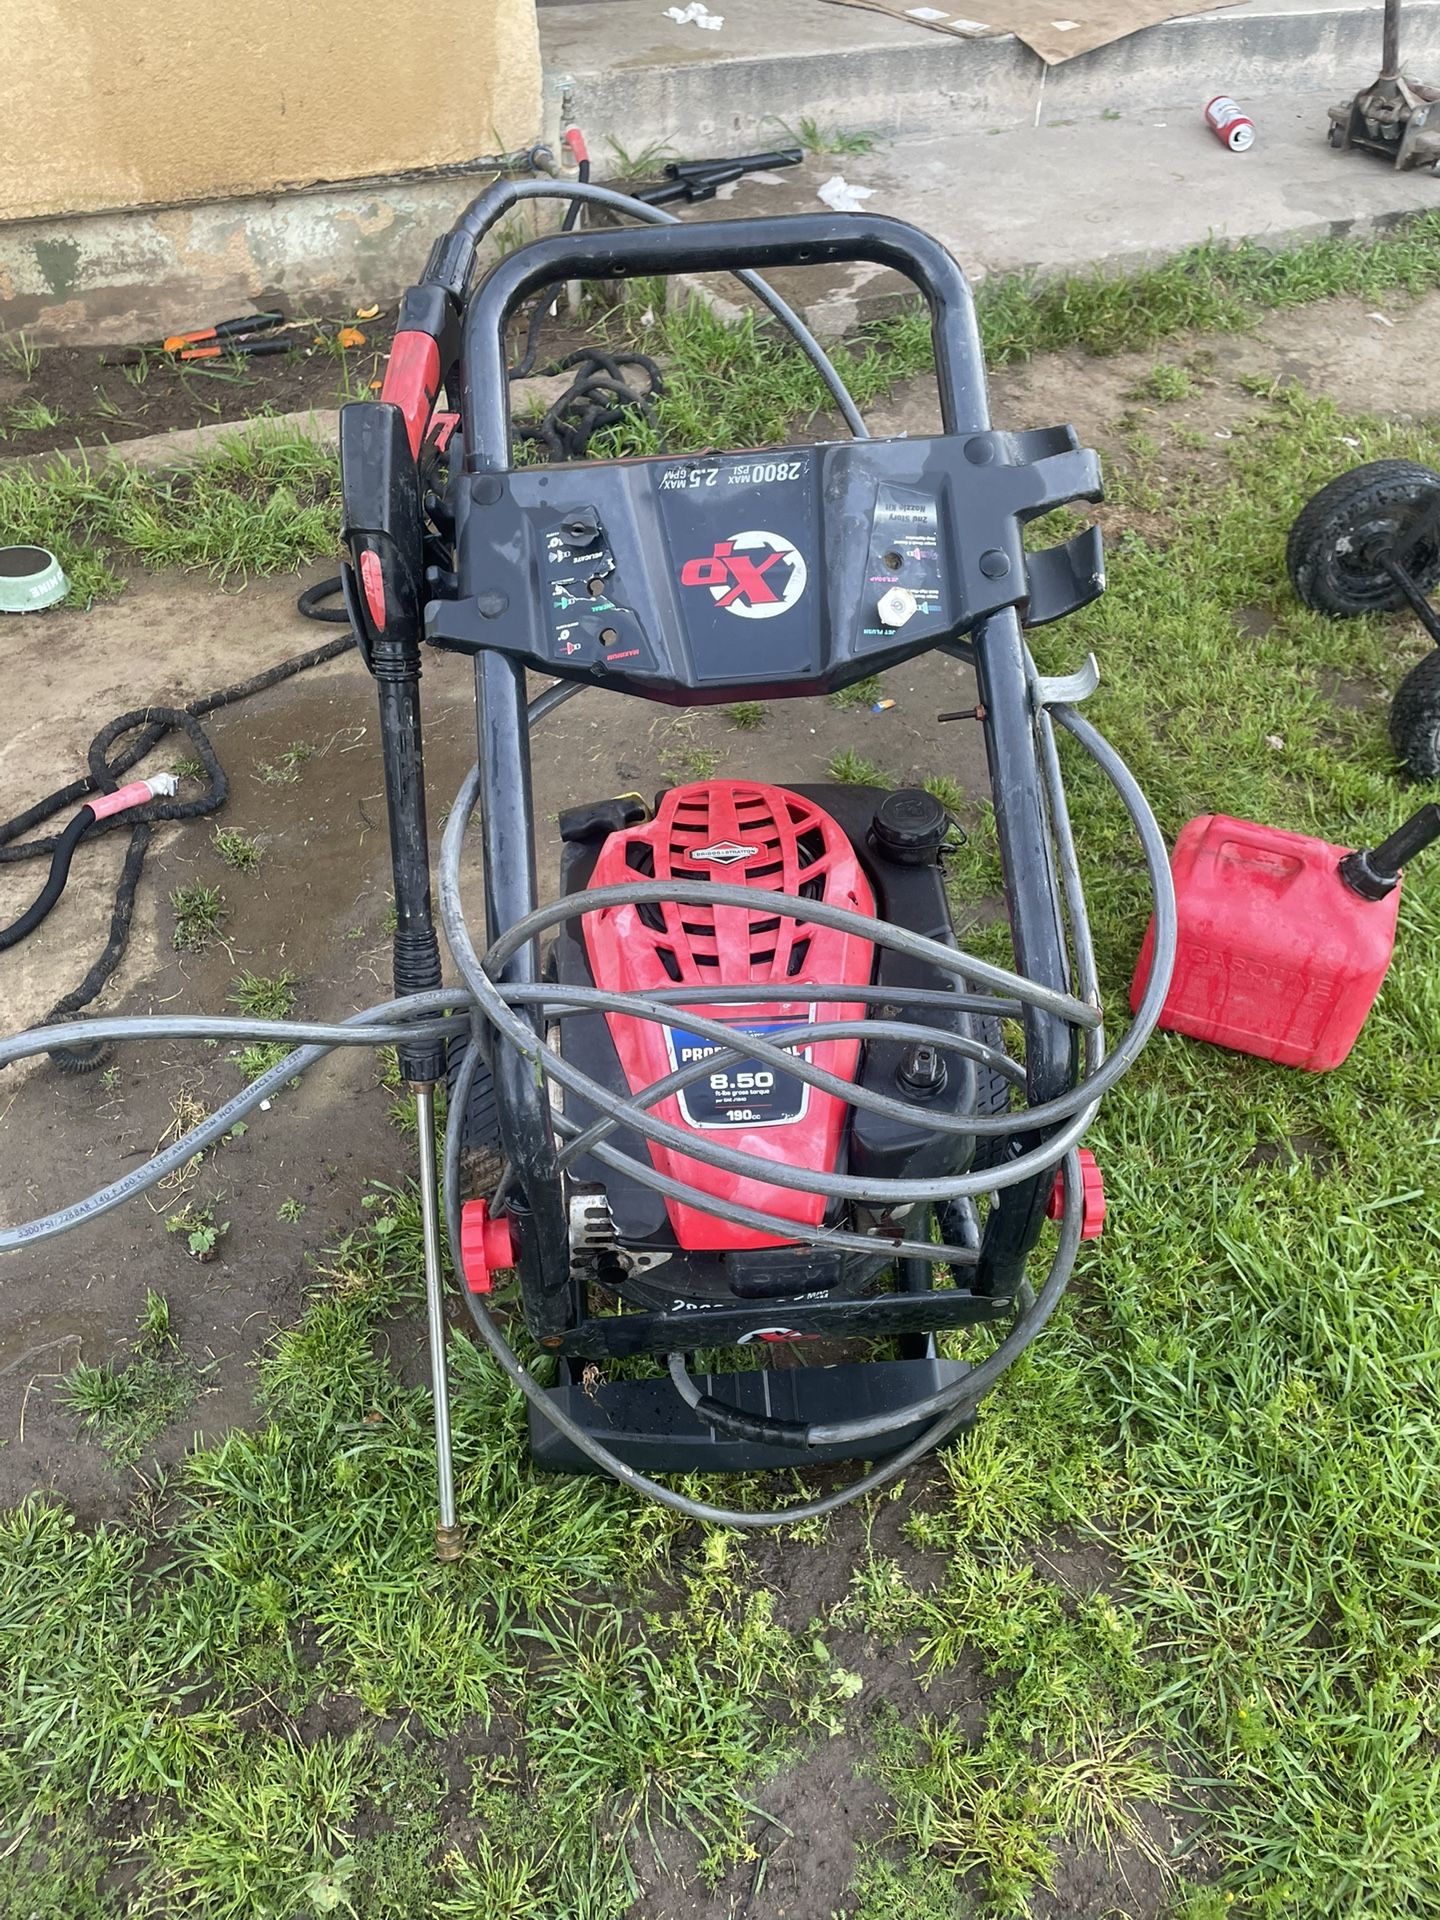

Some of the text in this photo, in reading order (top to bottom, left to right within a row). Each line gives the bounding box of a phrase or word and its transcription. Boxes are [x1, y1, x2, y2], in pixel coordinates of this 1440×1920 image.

[664, 468, 719, 489] 2.5 MAX
[728, 462, 801, 485] 2800 MAX
[734, 465, 750, 475] PSI
[710, 1071, 774, 1089] 8.50
